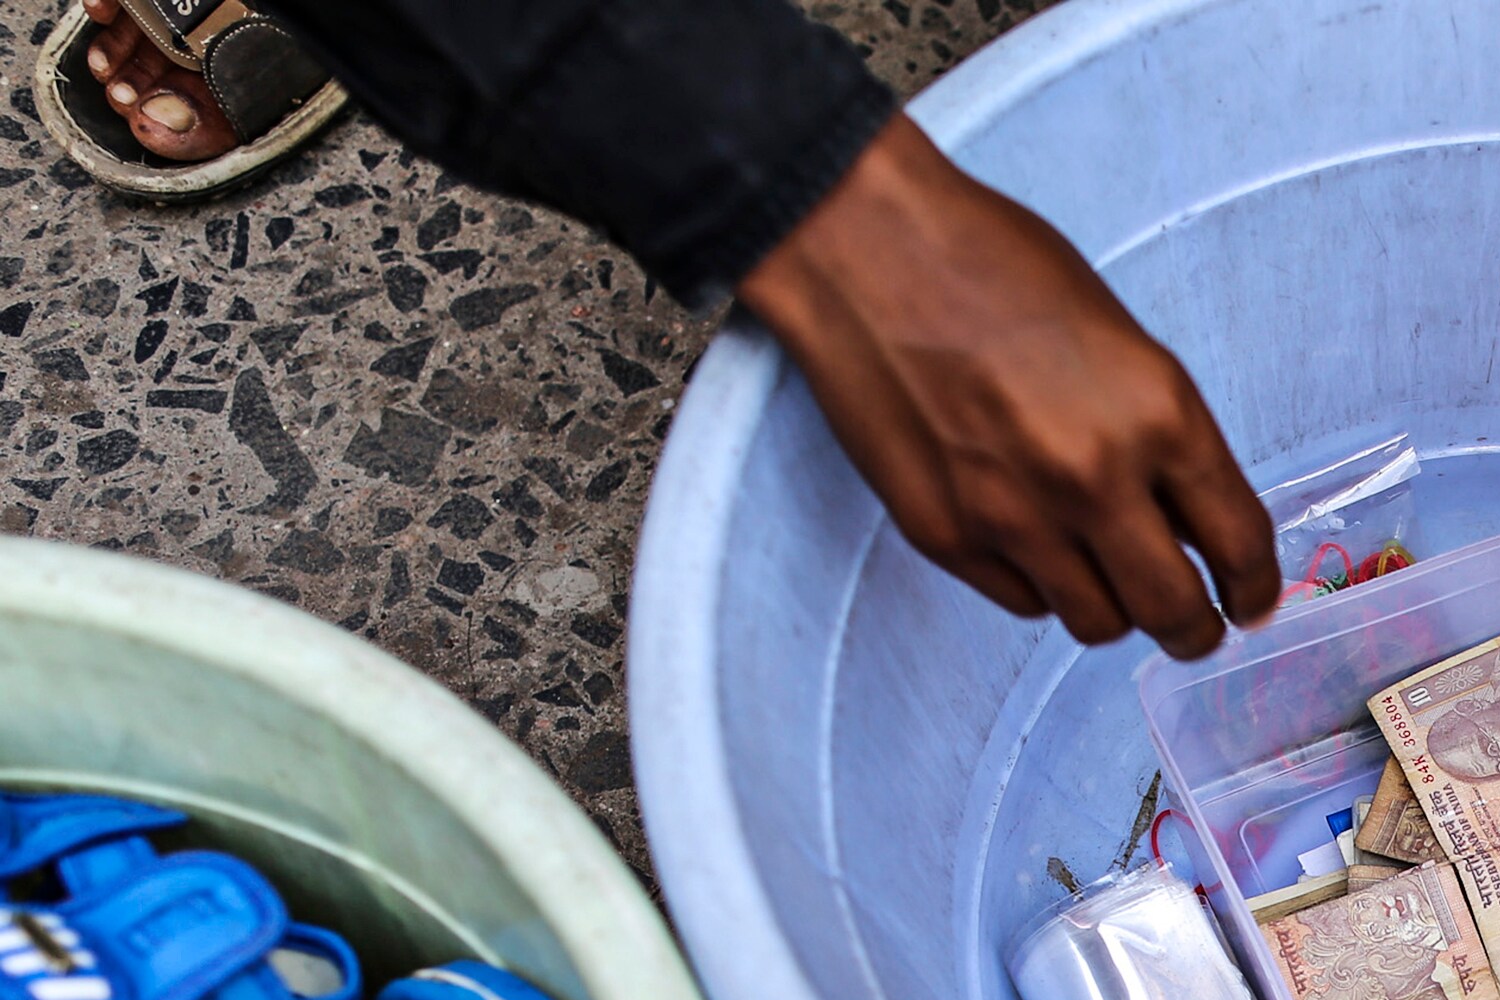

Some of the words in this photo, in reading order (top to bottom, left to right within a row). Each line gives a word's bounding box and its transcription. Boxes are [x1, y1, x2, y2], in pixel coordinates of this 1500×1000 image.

[1406, 685, 1433, 708] 10
[1380, 695, 1416, 748] 368804
[1410, 753, 1435, 786] 84K
[1442, 782, 1463, 816] INDIA
[1457, 815, 1471, 831] OF
[1464, 855, 1494, 909] भारती
